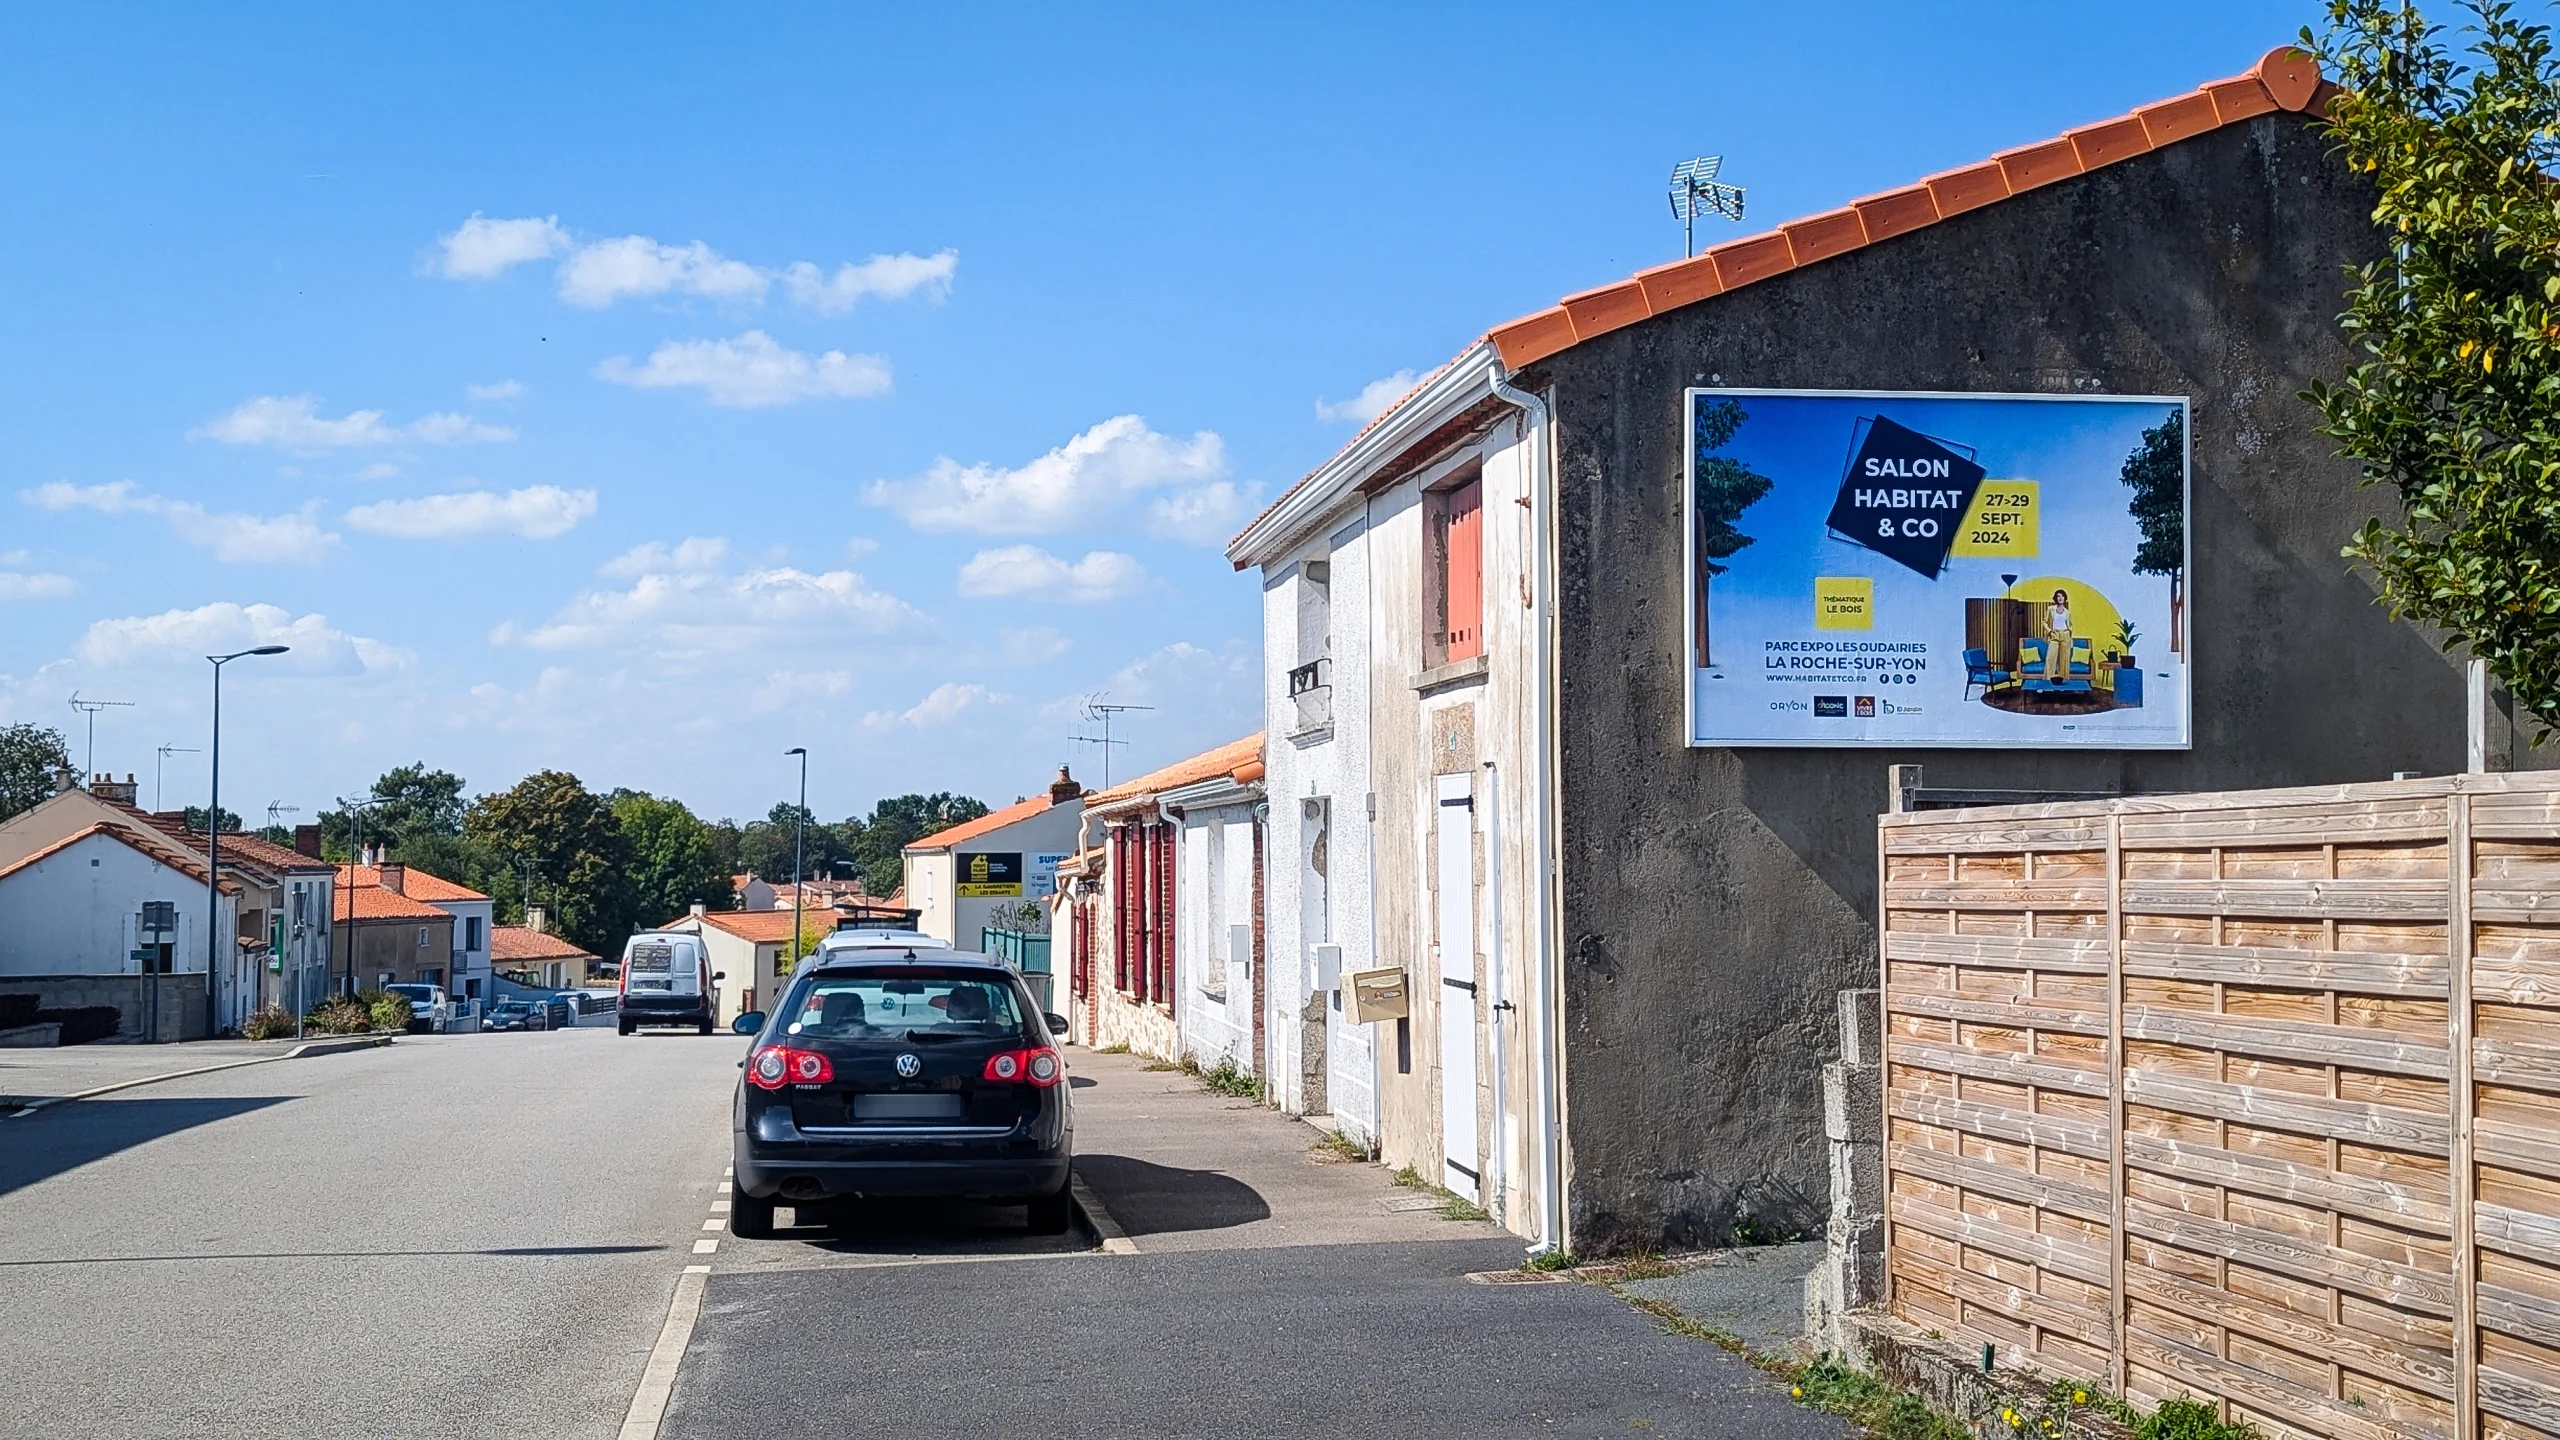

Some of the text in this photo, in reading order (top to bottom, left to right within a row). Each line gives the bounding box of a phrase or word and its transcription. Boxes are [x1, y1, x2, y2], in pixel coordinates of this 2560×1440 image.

[1865, 458, 1949, 478] SALON
[1854, 489, 1962, 509] HABITAT
[1985, 494, 2029, 507] 27>29
[1981, 512, 2024, 525] SEPT.
[1878, 518, 1938, 537] & CO
[1971, 531, 2010, 544] 2024
[1826, 605, 1863, 613] LE BOIS
[1765, 641, 1927, 653] PARC EXPO LES OUDAIRIES
[1765, 656, 1926, 670] LA ROCHE-SUR-YON
[1765, 674, 1867, 683] WWW.HABITATETCO.FR
[1770, 700, 1808, 713] ORYON
